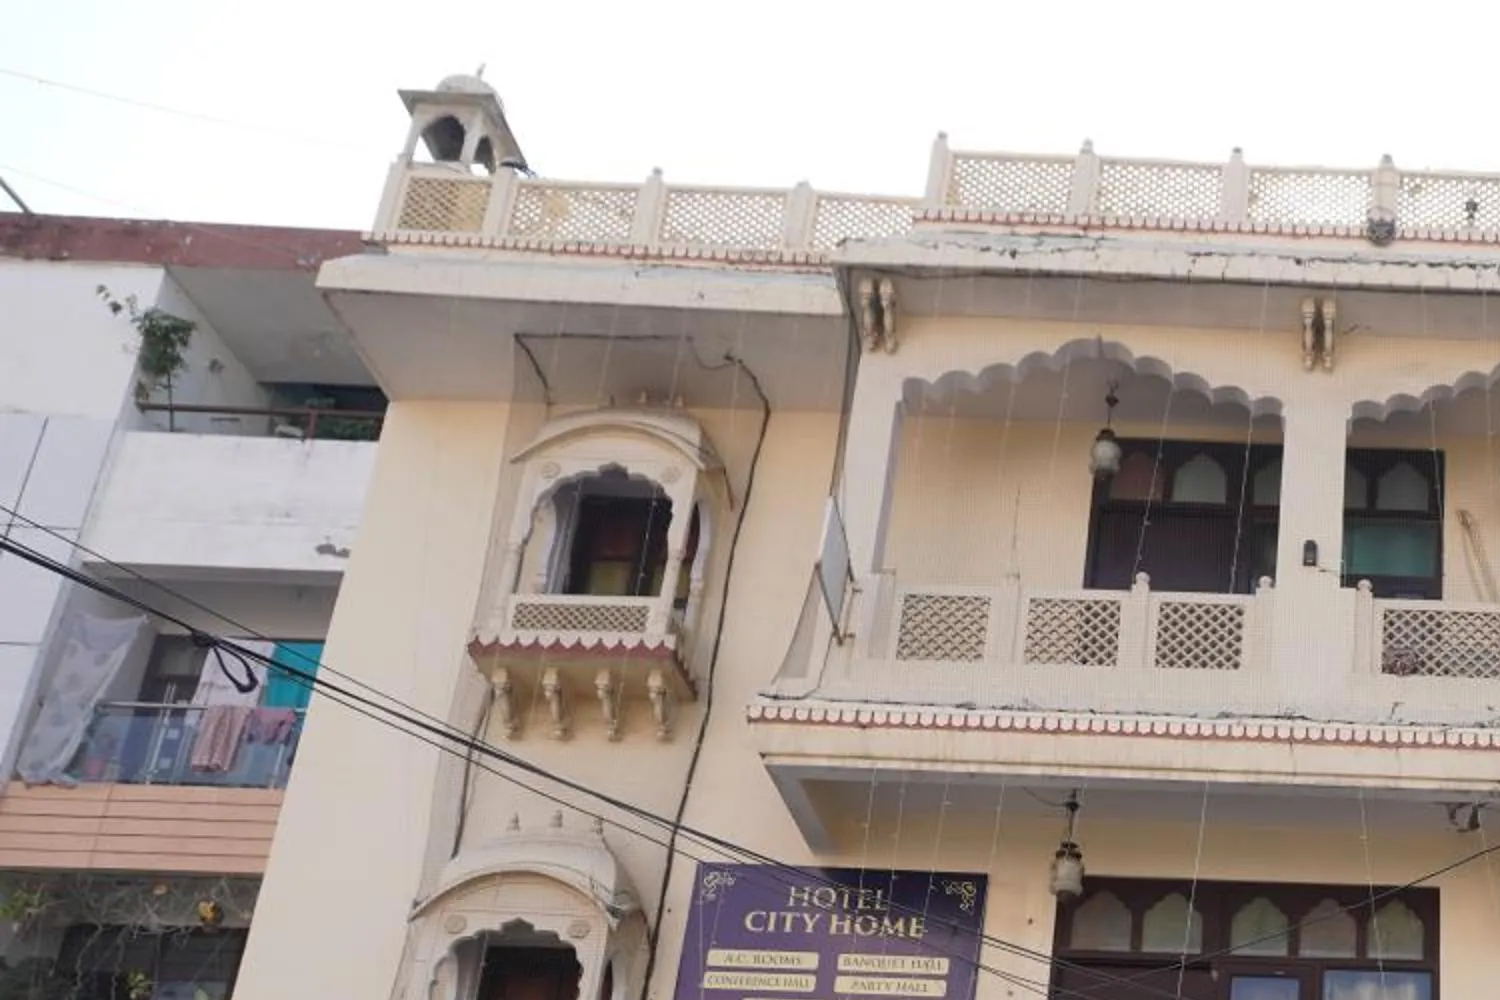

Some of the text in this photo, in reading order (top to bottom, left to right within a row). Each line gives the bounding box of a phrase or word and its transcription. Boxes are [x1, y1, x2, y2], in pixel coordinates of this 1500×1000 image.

[787, 885, 889, 912] HOTEL
[744, 910, 926, 939] CITY HOME
[850, 979, 929, 994] PARTY HALL
